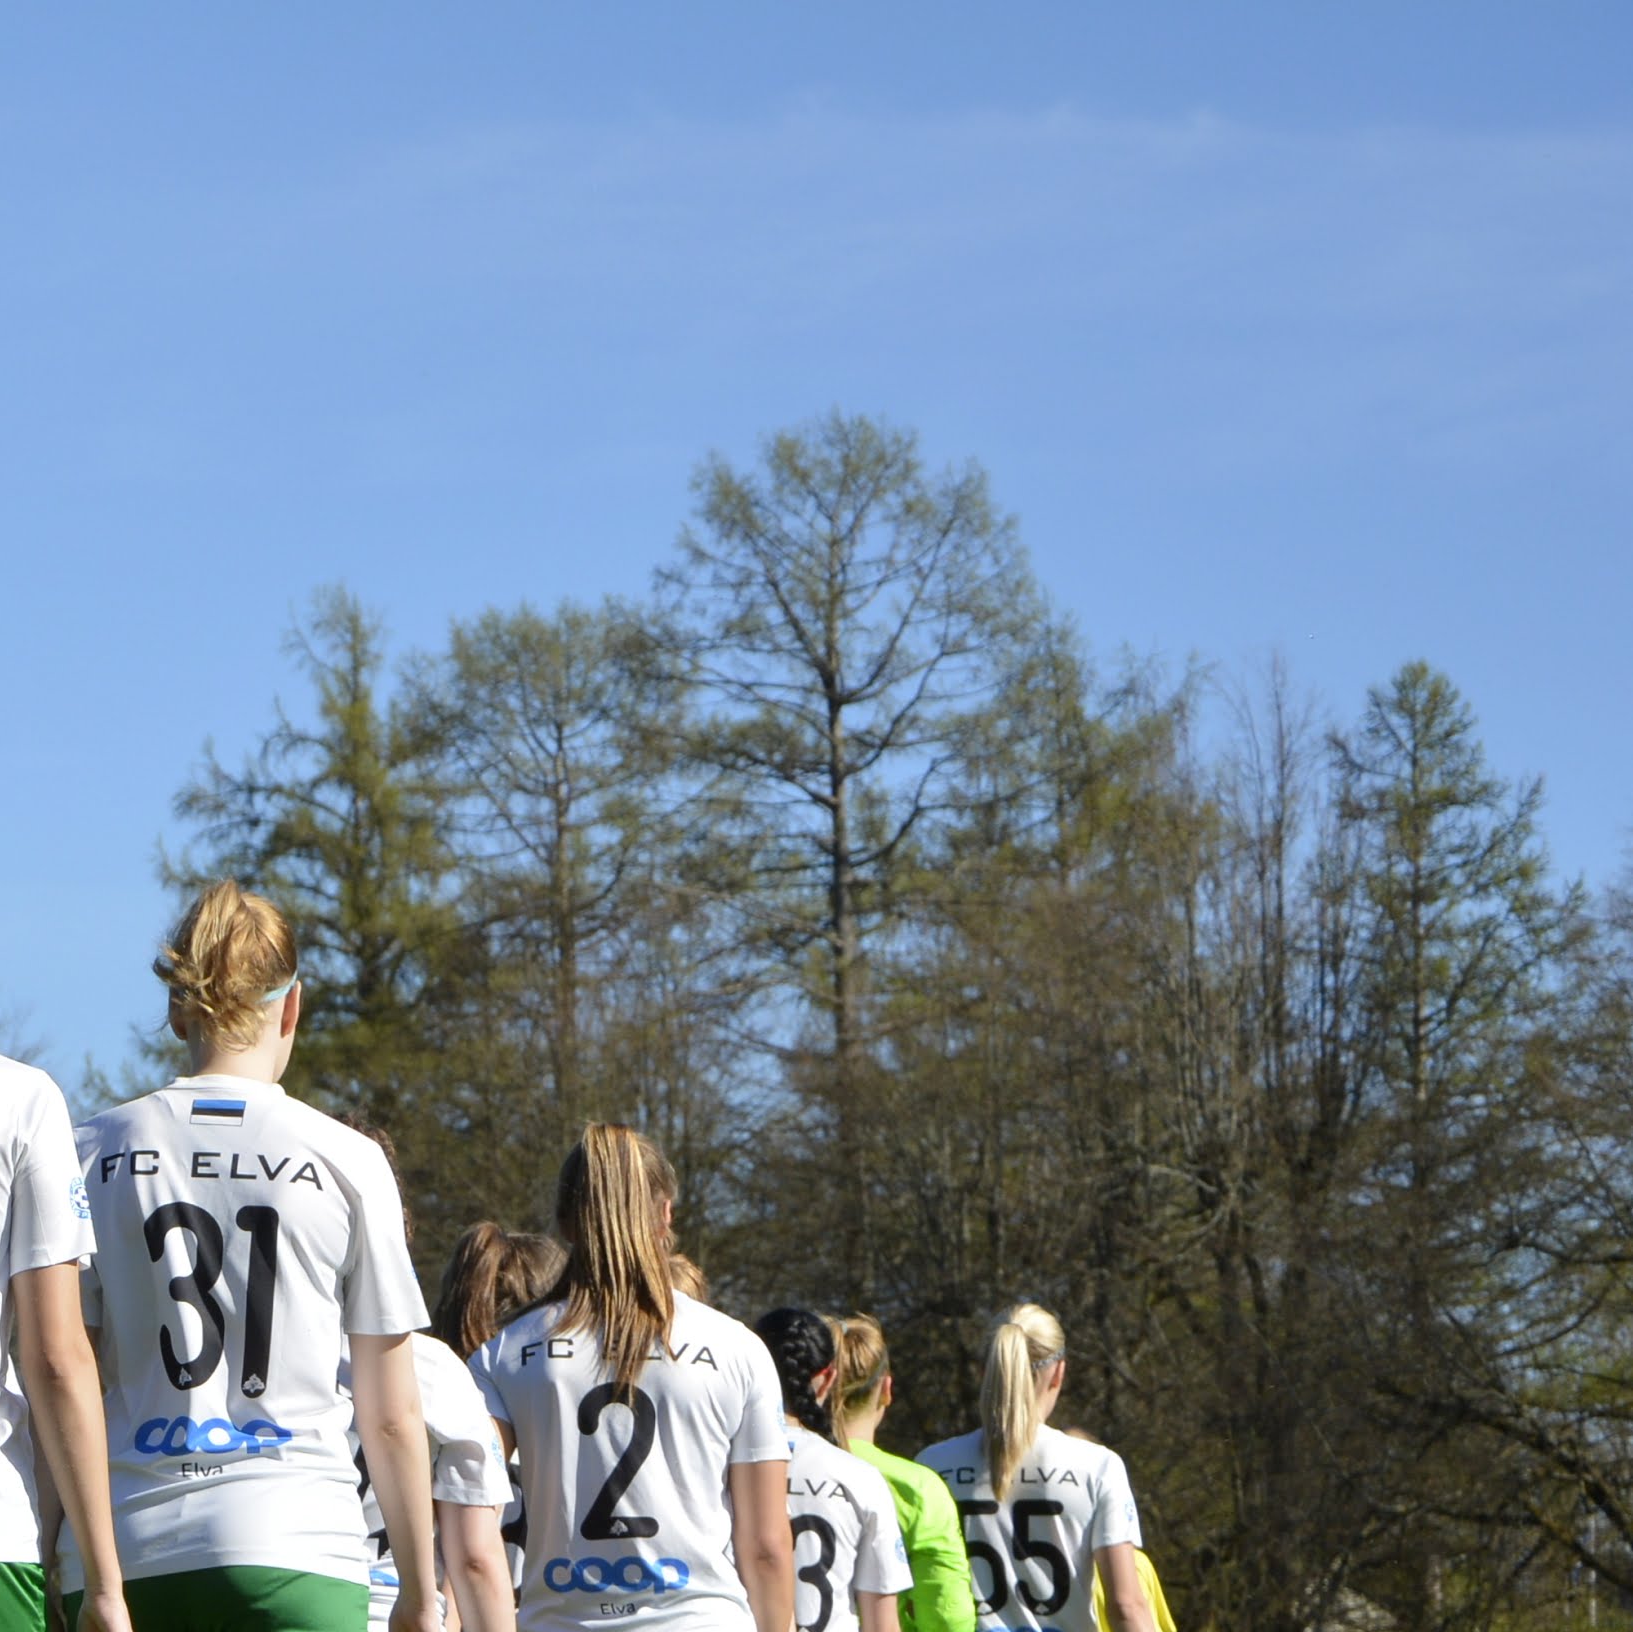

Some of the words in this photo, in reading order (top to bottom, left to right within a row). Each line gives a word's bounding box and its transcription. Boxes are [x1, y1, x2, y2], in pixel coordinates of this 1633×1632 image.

[101, 1150, 159, 1183] FC
[190, 1152, 324, 1191] ELVA
[143, 1201, 279, 1398] 31
[521, 1338, 575, 1366] FC
[134, 1416, 293, 1456] coop
[181, 1462, 224, 1478] Elva
[577, 1381, 659, 1540] 2
[1011, 1467, 1079, 1486] LVA
[787, 1477, 851, 1502] LVA
[543, 1556, 690, 1594] coop
[958, 1499, 1071, 1615] 55
[600, 1601, 636, 1615] Elva
